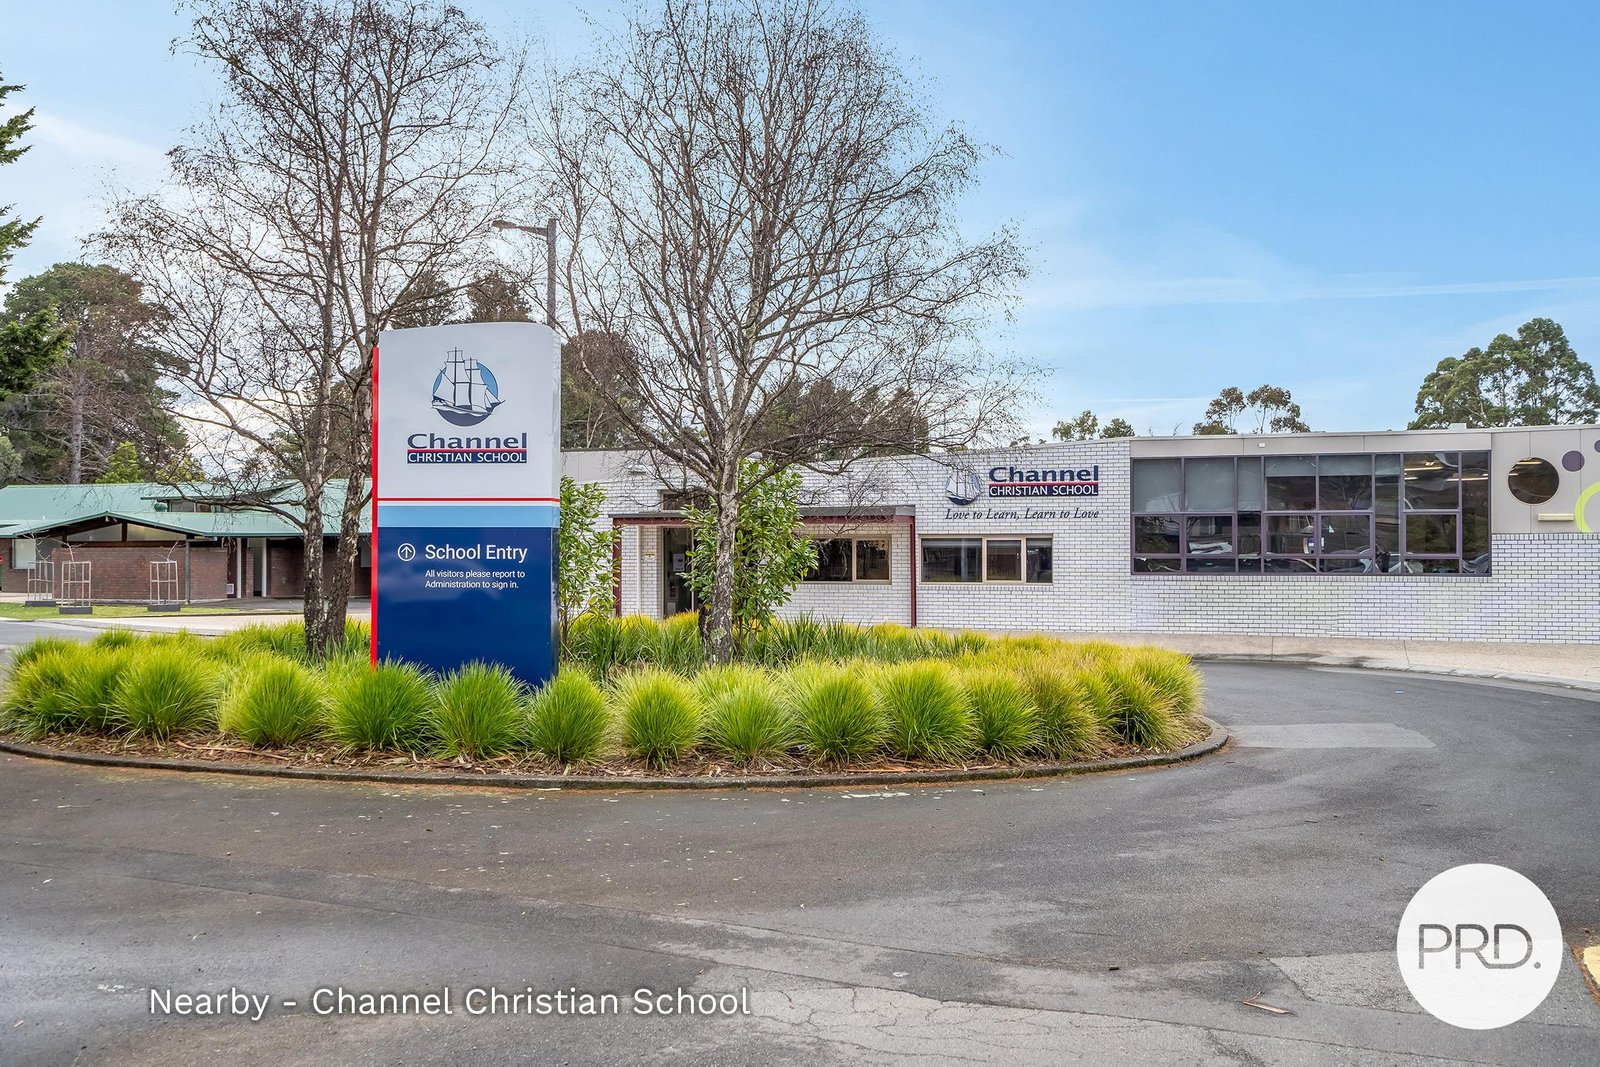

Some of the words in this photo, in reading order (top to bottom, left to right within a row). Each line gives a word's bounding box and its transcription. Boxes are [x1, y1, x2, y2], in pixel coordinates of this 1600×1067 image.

[407, 432, 527, 449] Channel
[408, 452, 472, 463] CHRISTIAN
[477, 452, 526, 463] SCHOOL
[988, 465, 1099, 482] Channel
[989, 485, 1048, 496] CHRISTIAN
[1052, 484, 1098, 496] SCHOOL
[945, 509, 970, 520] Love
[972, 510, 983, 520] to
[985, 509, 1020, 521] Learn,
[1024, 508, 1056, 519] Learn
[1059, 509, 1070, 519] to
[1073, 508, 1099, 519] Love
[425, 544, 481, 560] School
[486, 544, 528, 564] Entry
[425, 570, 435, 578] All
[436, 570, 464, 578] visitors
[465, 570, 491, 579] please
[492, 570, 515, 579] report
[517, 570, 526, 578] to
[425, 580, 481, 589] Administration
[482, 581, 491, 589] to
[491, 580, 508, 591] sign
[509, 581, 519, 589] in.
